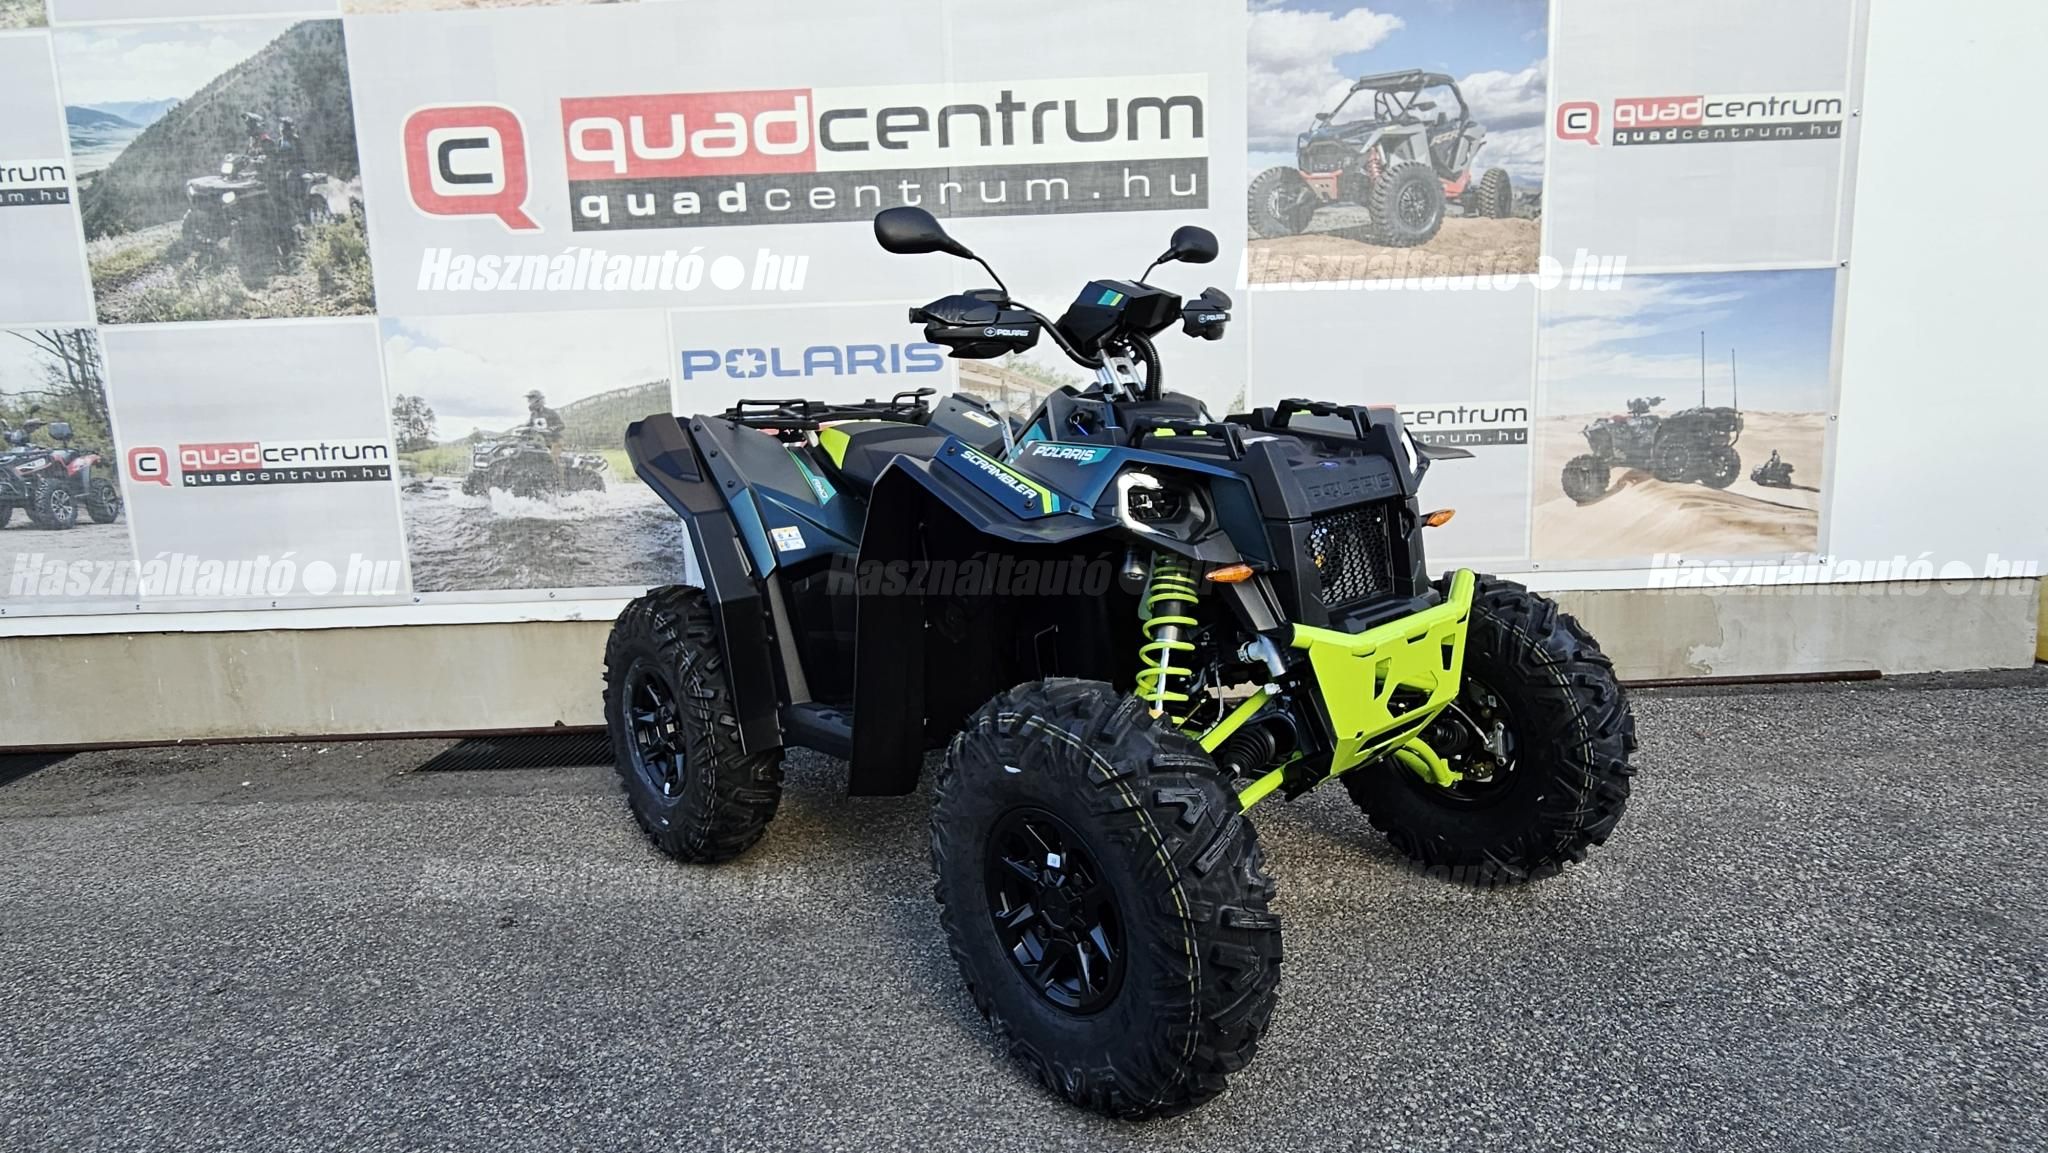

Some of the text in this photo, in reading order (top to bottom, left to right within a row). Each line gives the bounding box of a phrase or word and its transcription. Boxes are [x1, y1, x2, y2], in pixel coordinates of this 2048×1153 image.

[1615, 96, 1842, 125] quadcentrum
[568, 89, 1204, 174] quadcentrum
[1616, 124, 1839, 143] quadcentrum.hu
[580, 168, 1198, 224] quadcentrum.hu
[681, 342, 945, 380] POLARIS
[1412, 429, 1525, 444] trum.hu
[181, 442, 389, 468] quadcentrum
[1032, 445, 1097, 461] POLARIS
[184, 467, 389, 485] quadcentrum.hu
[961, 449, 1038, 499] SCRAMBLER
[1307, 472, 1394, 498] POLARIS
